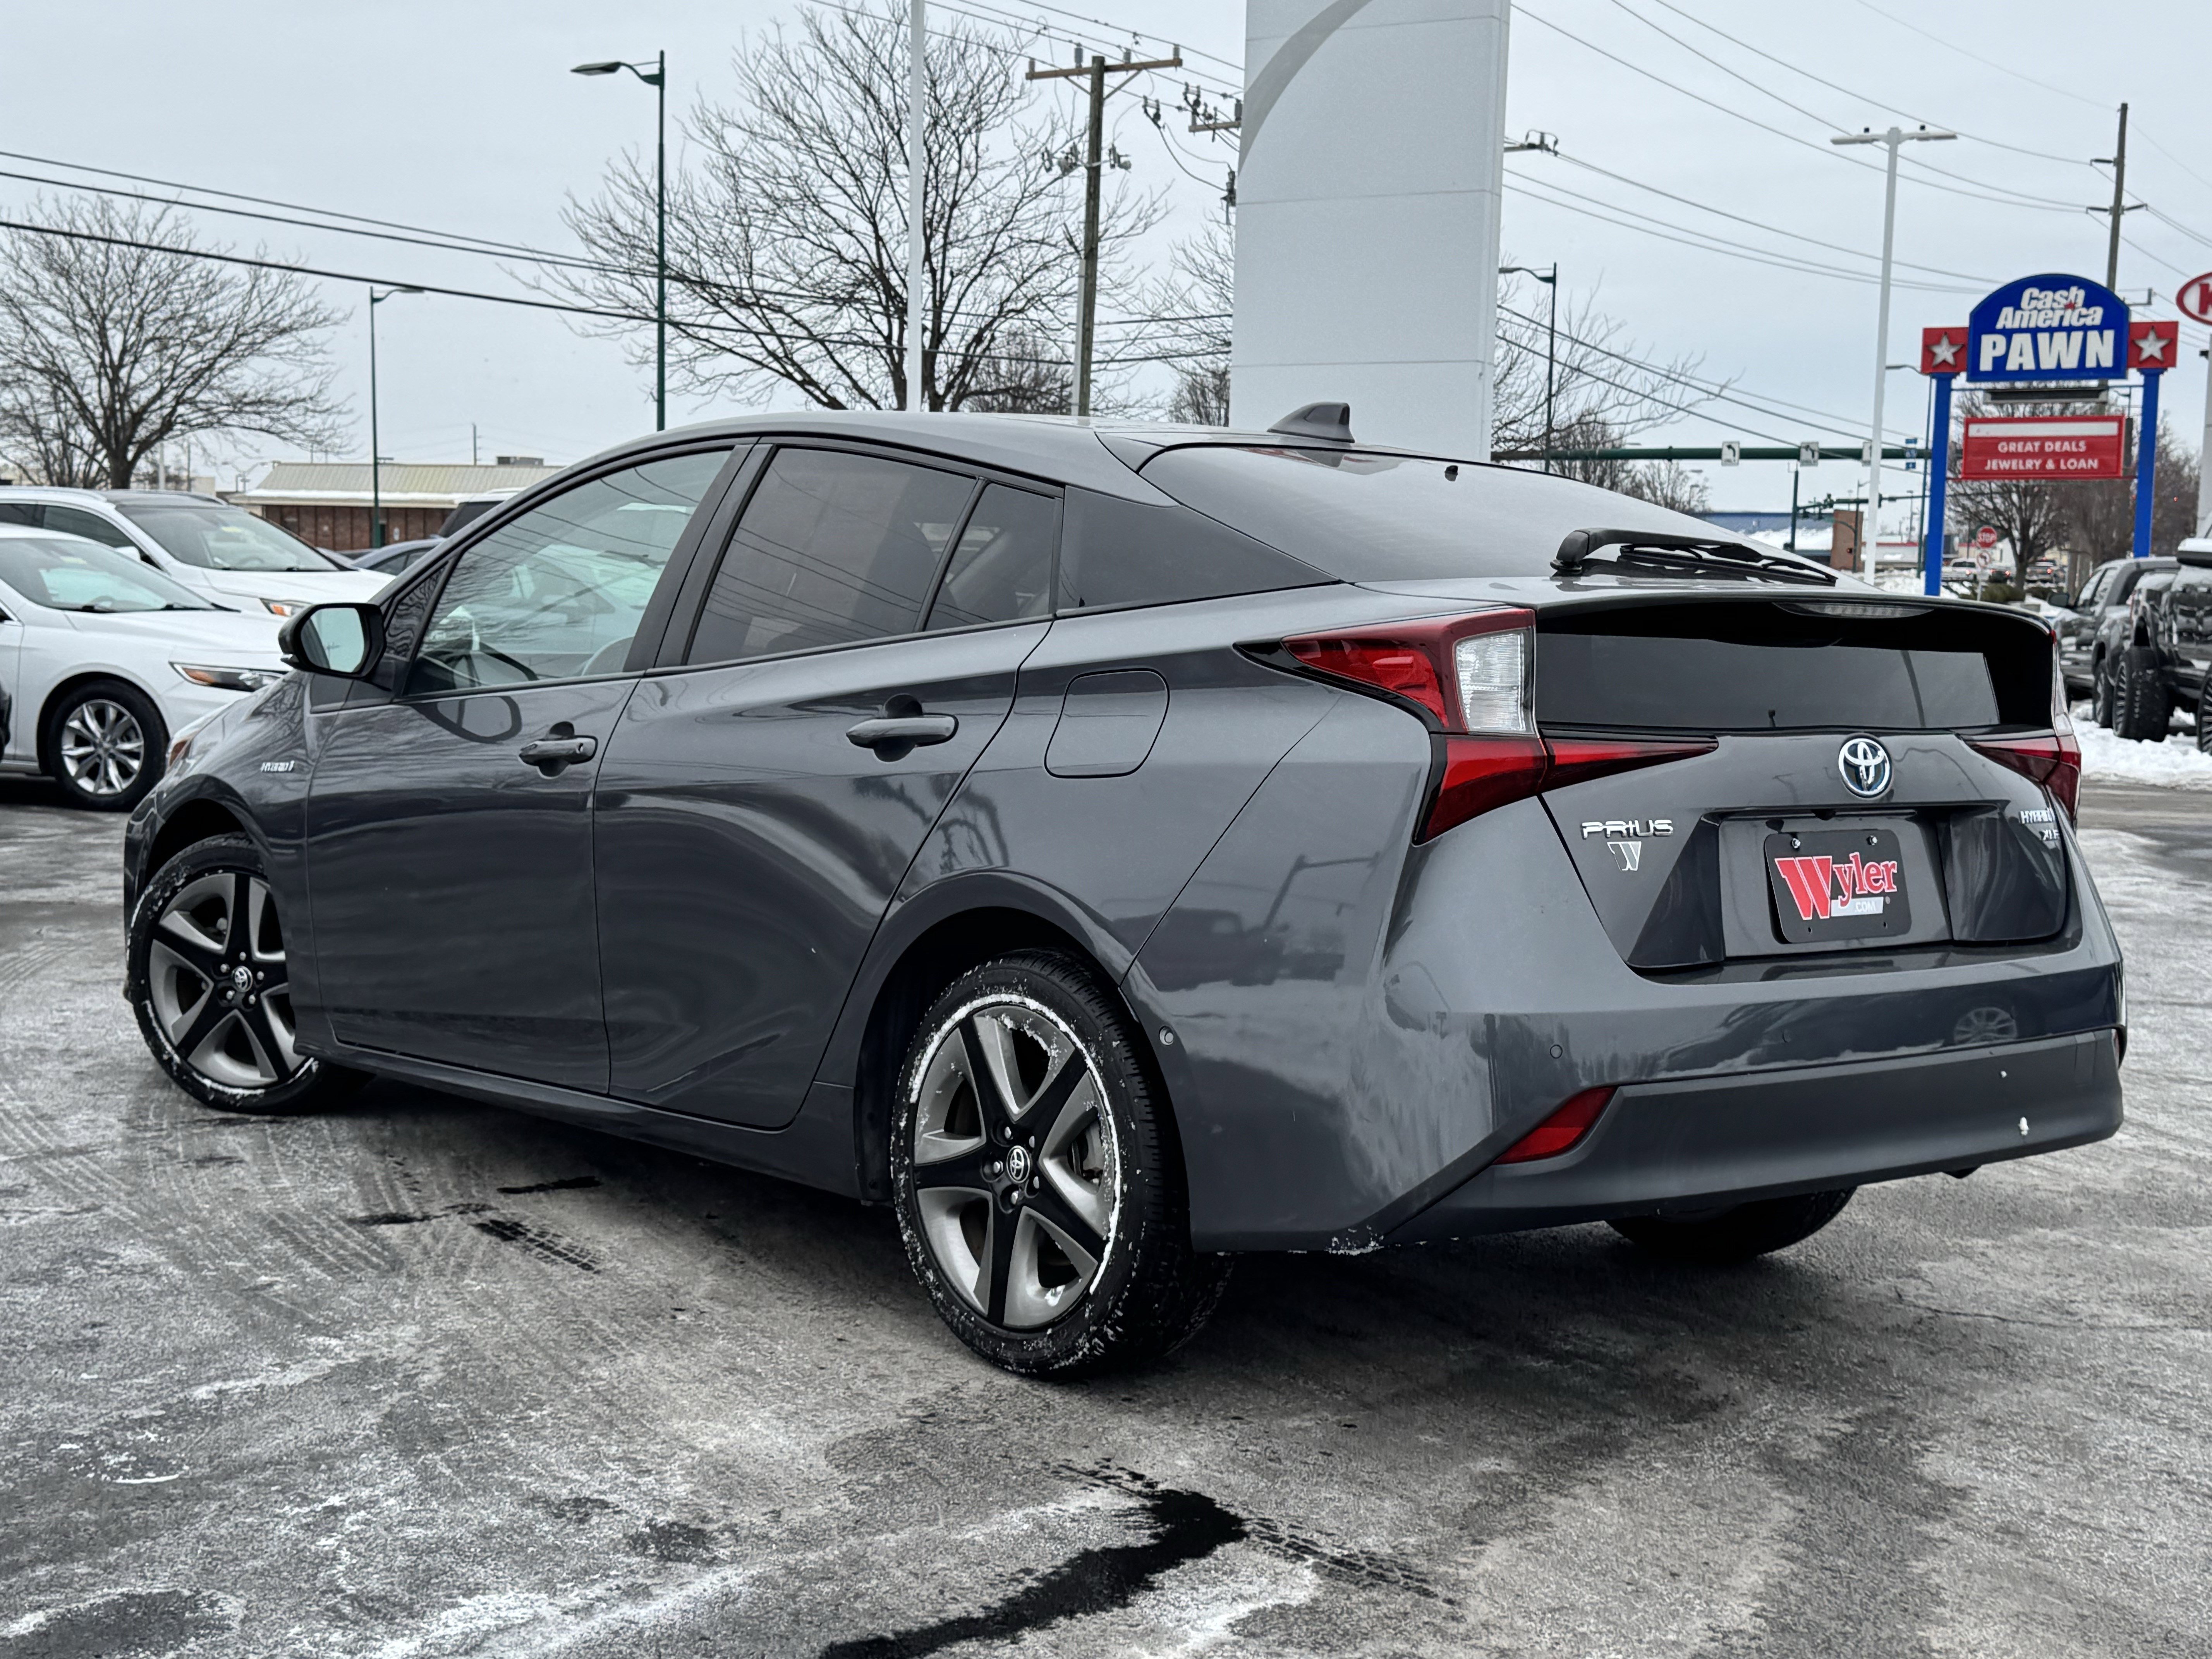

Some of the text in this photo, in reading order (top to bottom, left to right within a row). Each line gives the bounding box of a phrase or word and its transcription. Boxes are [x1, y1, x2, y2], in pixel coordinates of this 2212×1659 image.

[2020, 286, 2085, 310] Cash
[1995, 306, 2104, 329] America
[1979, 330, 2115, 372] PAWN
[1997, 440, 2087, 453] GREAT DEALS
[1984, 458, 2099, 471] JEWELRY & LOAN
[1978, 532, 1996, 543] STOP
[1582, 819, 1673, 839] PRIUS
[1775, 852, 1897, 920] Wyler
